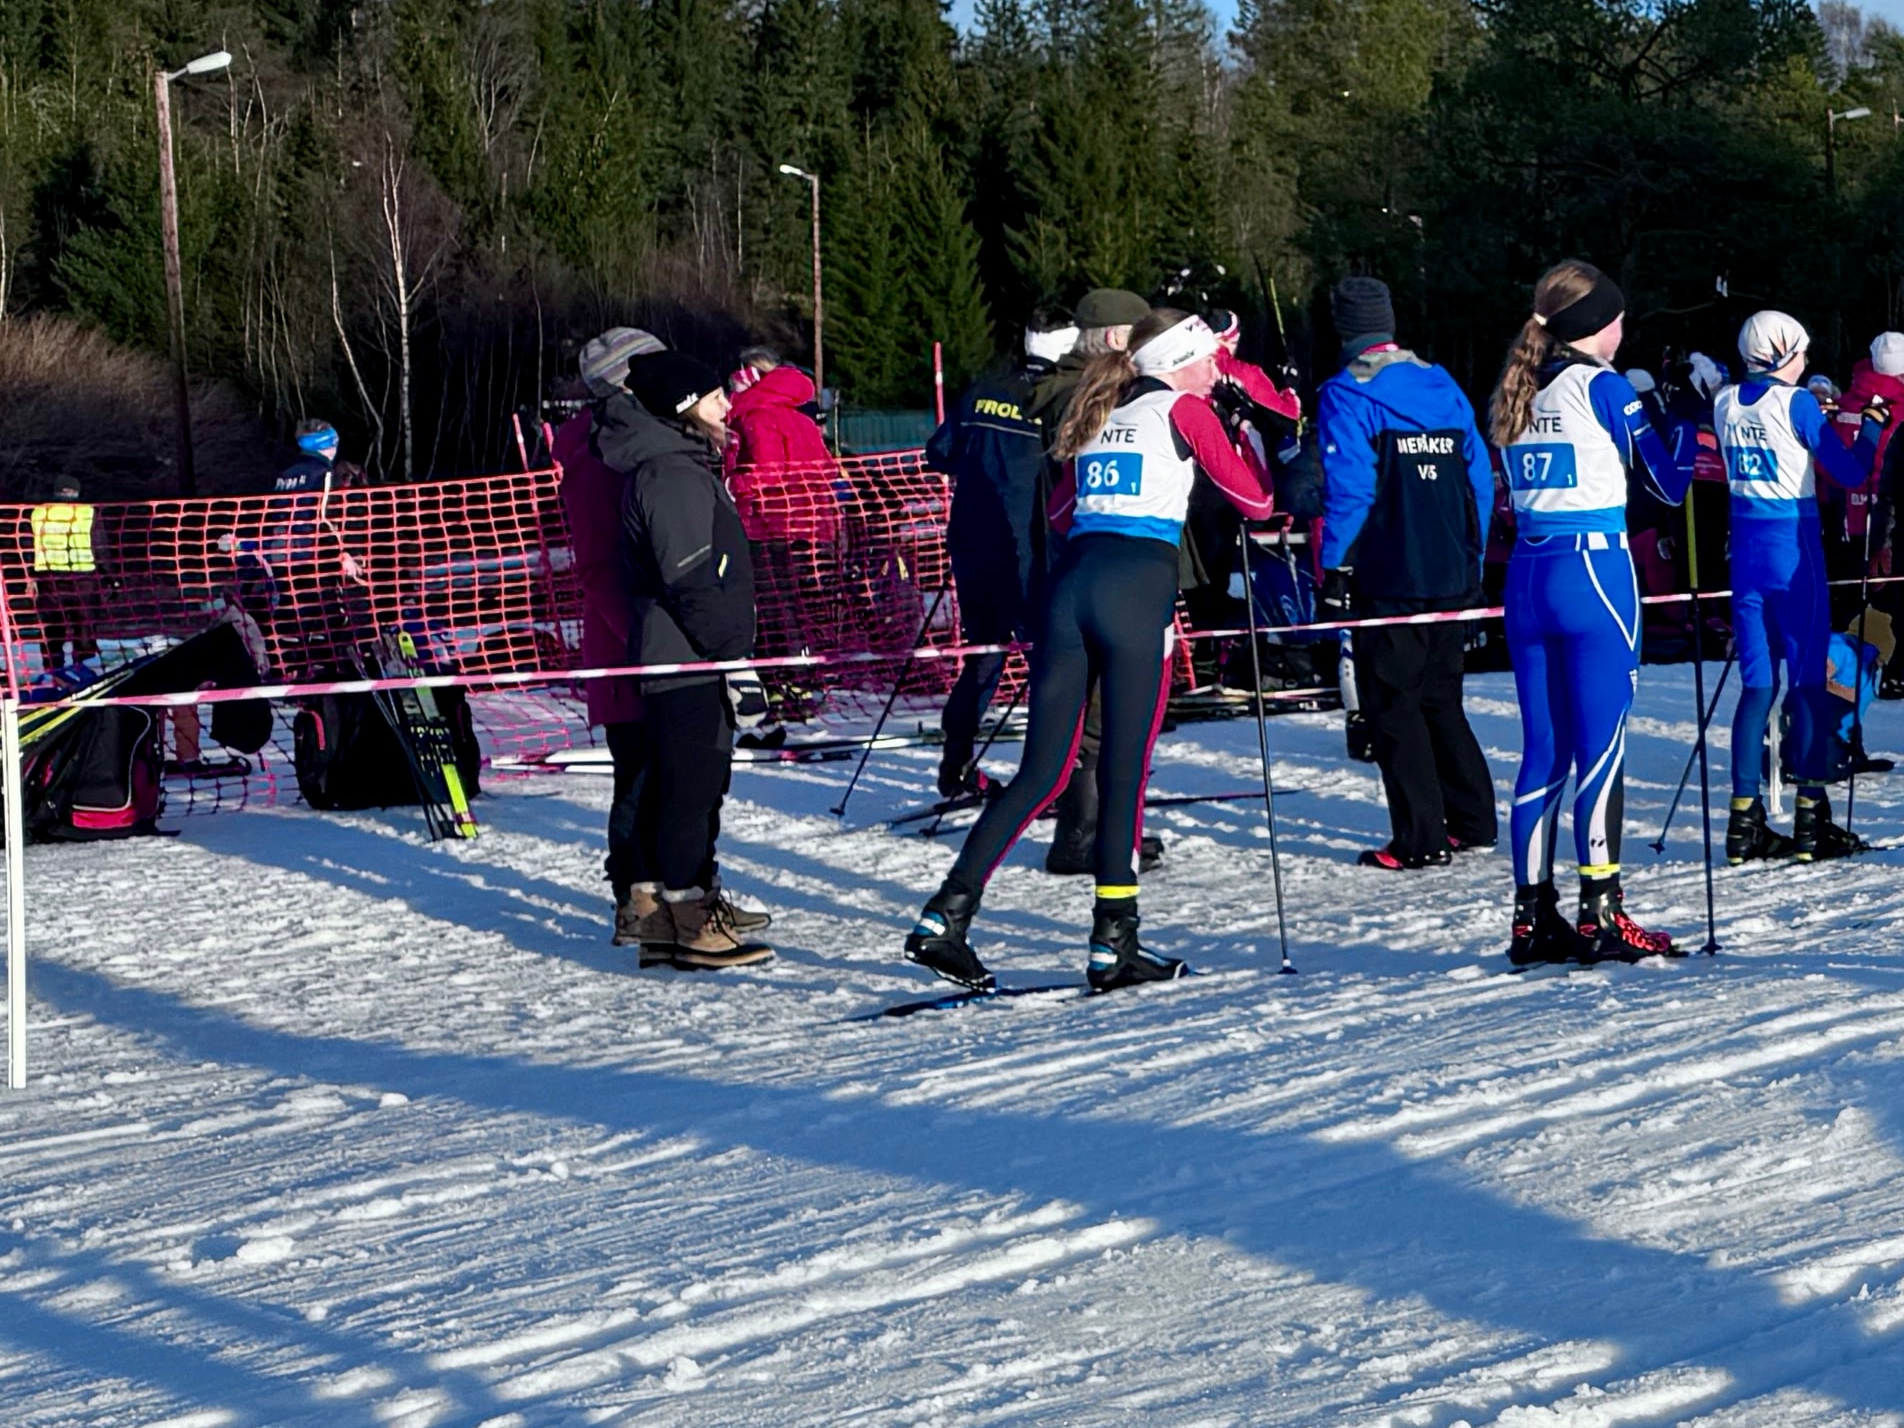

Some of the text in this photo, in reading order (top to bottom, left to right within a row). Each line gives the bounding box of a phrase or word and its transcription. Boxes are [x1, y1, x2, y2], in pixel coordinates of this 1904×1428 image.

[975, 399, 1024, 420] FROL
[1100, 428, 1137, 444] NTE
[1529, 417, 1563, 434] NTE
[1740, 426, 1767, 442] NTE
[1086, 460, 1120, 488] 86
[1523, 452, 1553, 482] 87
[1738, 452, 1762, 476] 82
